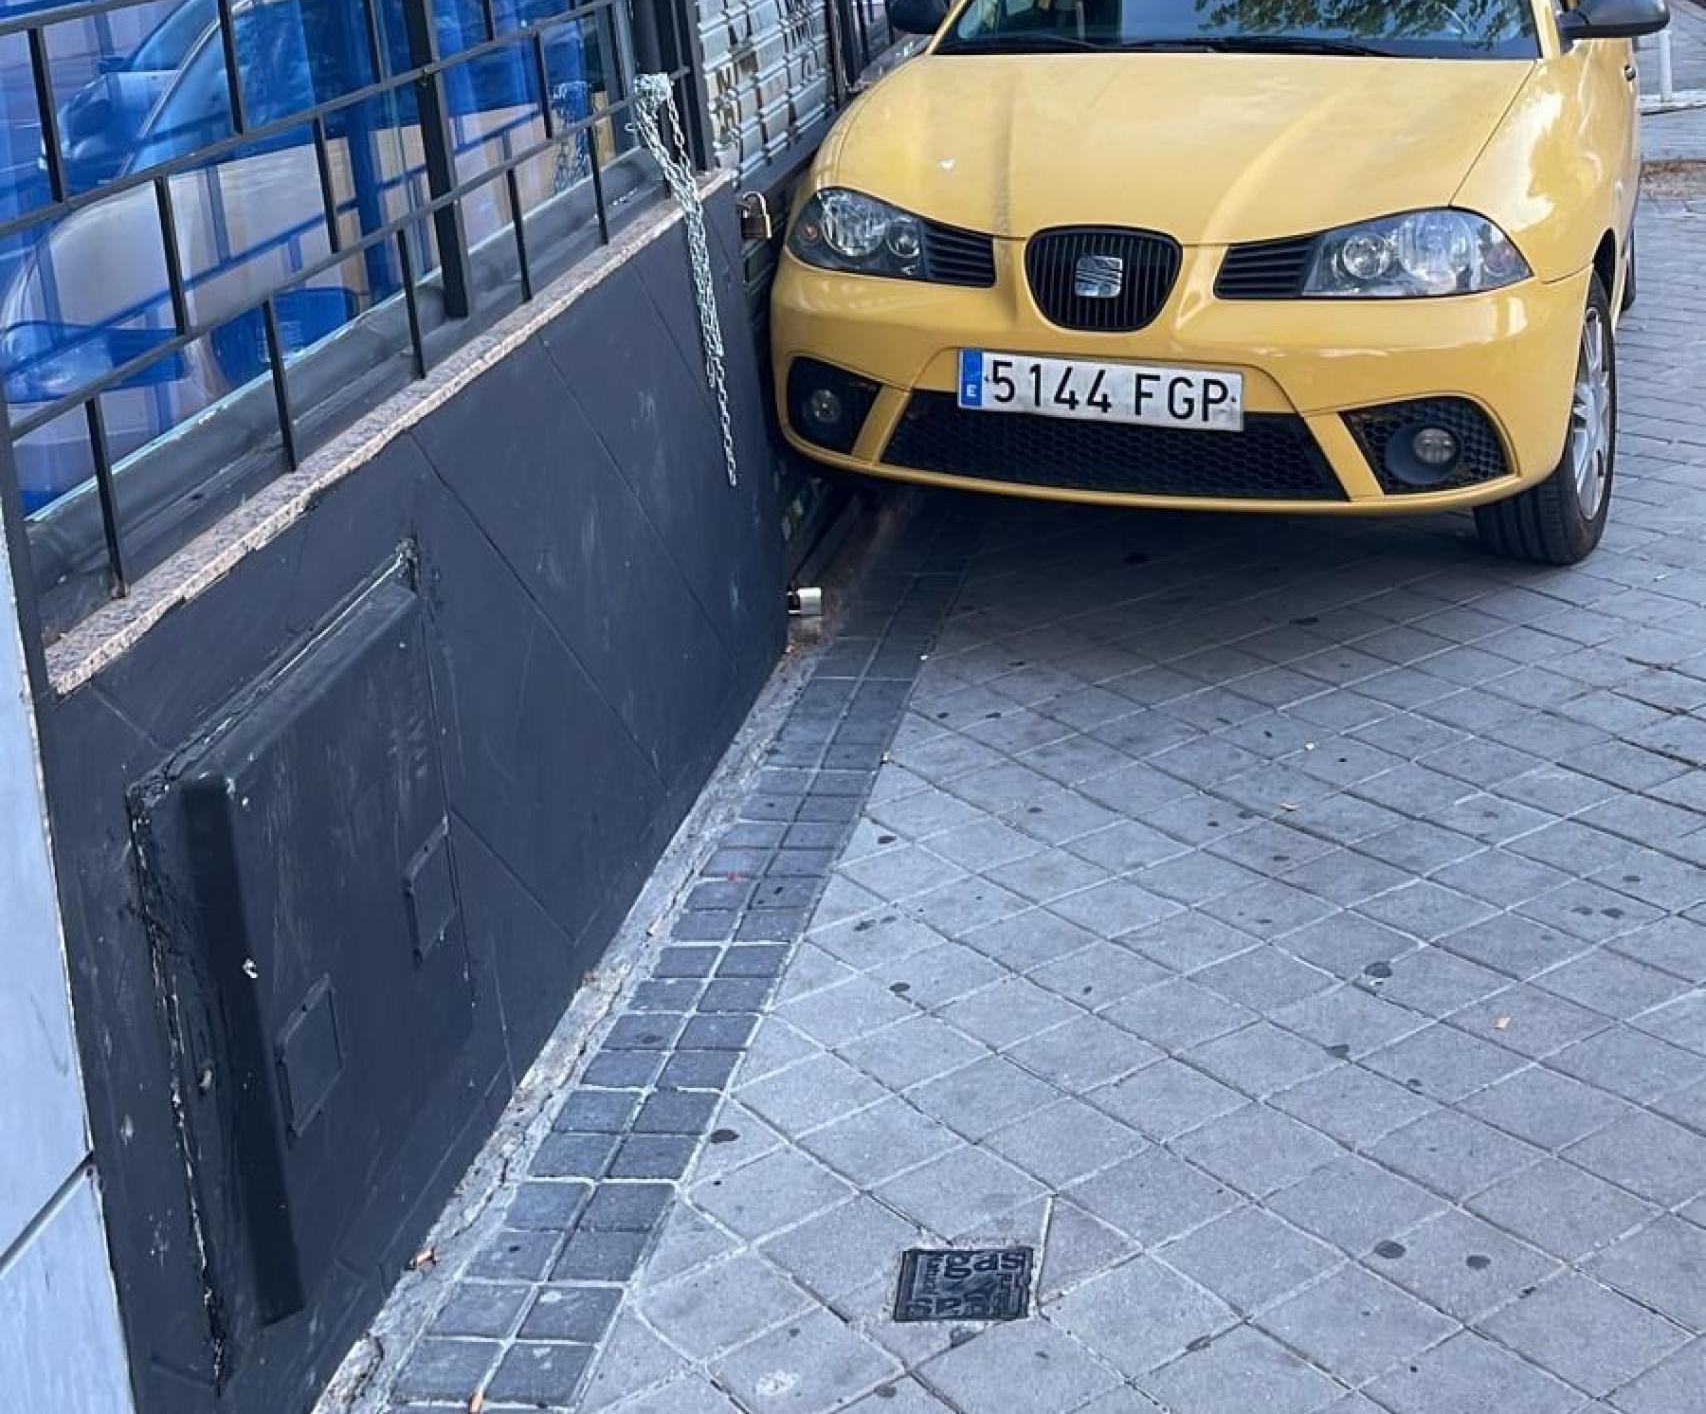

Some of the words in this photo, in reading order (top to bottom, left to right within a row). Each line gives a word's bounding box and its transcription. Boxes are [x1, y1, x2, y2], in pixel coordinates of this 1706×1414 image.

[966, 384, 977, 398] E
[991, 359, 1113, 414] 5144
[1134, 373, 1229, 422] FGP
